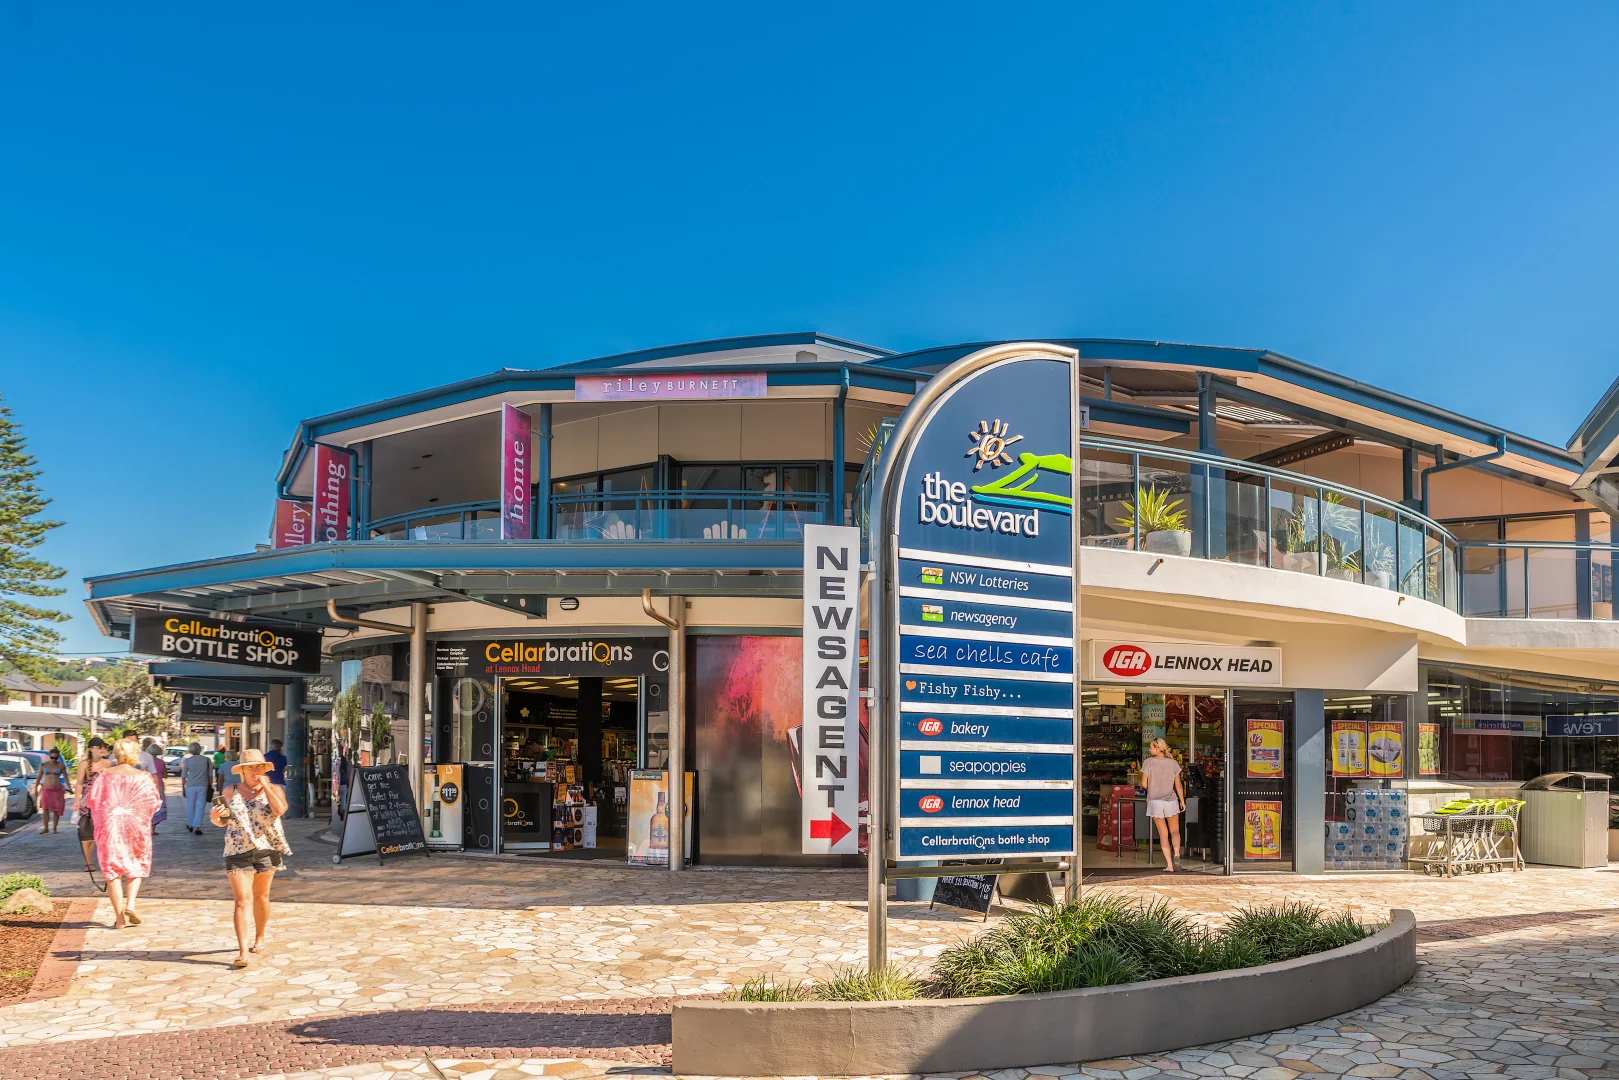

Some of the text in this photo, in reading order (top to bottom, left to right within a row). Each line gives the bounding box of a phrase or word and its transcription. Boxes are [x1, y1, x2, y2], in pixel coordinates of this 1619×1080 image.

[603, 378, 738, 394] riley BURNETT
[510, 440, 524, 523] home
[923, 471, 967, 503] the
[920, 494, 1039, 536] boulevard
[284, 504, 311, 547] llery
[950, 571, 1029, 591] NSW Lotteries
[951, 611, 1018, 629] newsagency
[164, 618, 294, 650] Cellarbrations
[161, 634, 299, 666] BOTTLE SHOP
[485, 641, 633, 666] Cellarbrations
[914, 644, 1060, 672] sea chells cafe
[495, 664, 520, 673] Lennox
[521, 664, 541, 673] Head
[1108, 650, 1273, 673] IGA LENNOX HEAD
[812, 546, 854, 808] NEWSAGENT
[919, 682, 1021, 700] Fishy Fishy...
[199, 694, 253, 711] bakery
[920, 721, 989, 738] IGA bakery
[1337, 722, 1361, 730] SPECIAL
[1373, 723, 1397, 731] SPECIAL
[363, 771, 383, 782] Come
[385, 771, 393, 779] in
[949, 760, 1027, 775] seapoppies
[921, 795, 1021, 809] IGA lennox head
[380, 841, 424, 854] Cellarbrations
[921, 833, 1050, 849] Cellarbrations bottle shop
